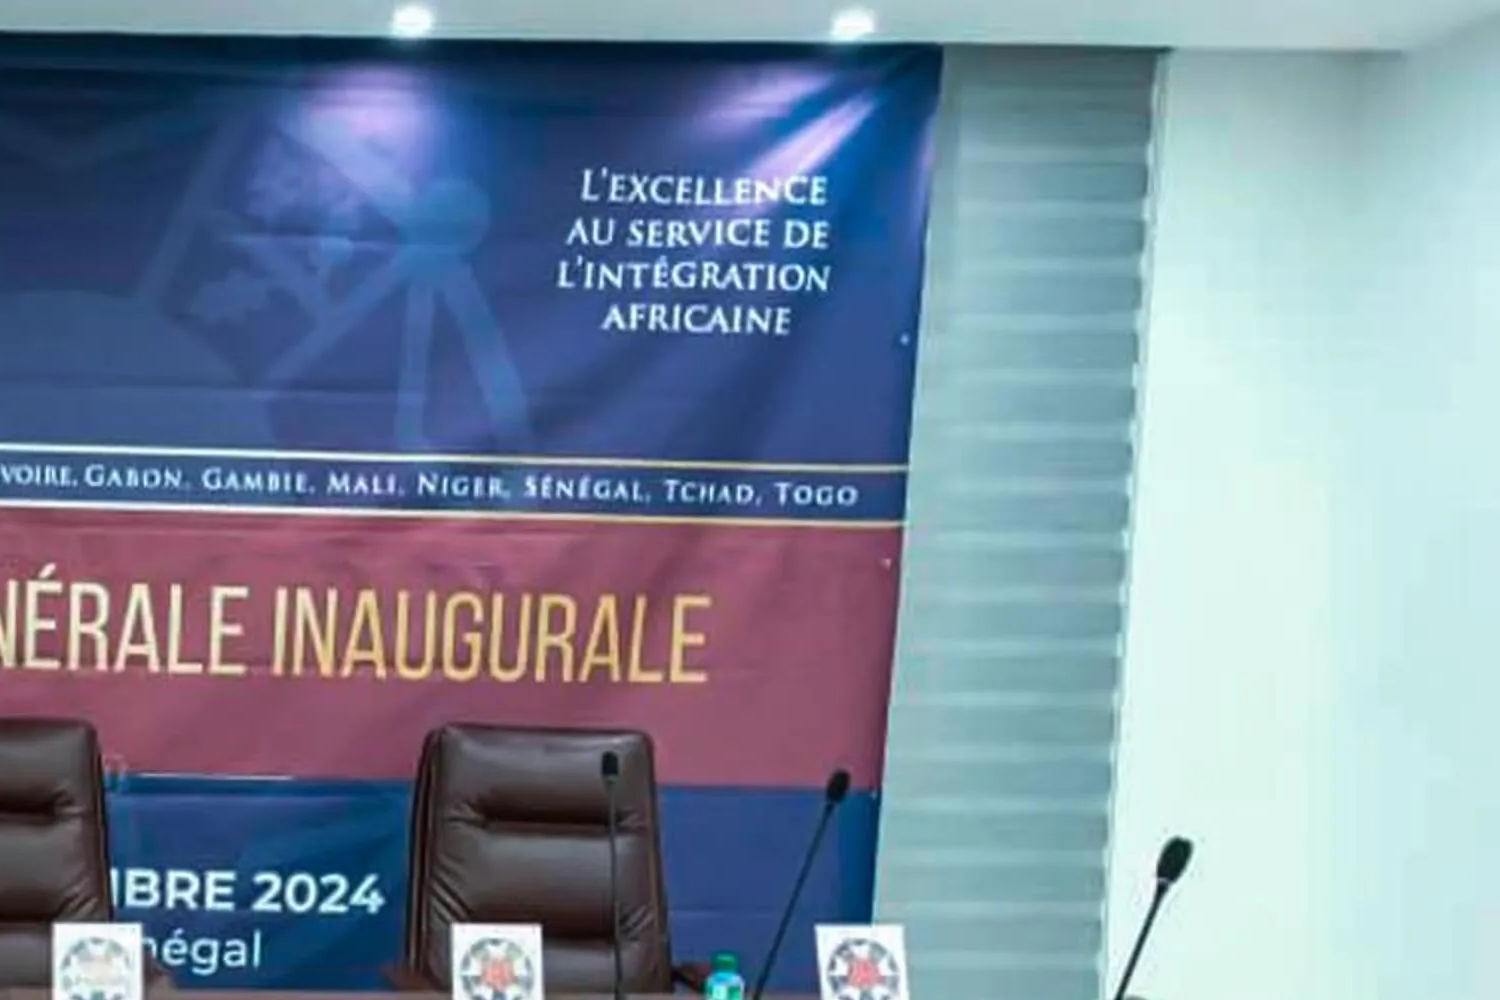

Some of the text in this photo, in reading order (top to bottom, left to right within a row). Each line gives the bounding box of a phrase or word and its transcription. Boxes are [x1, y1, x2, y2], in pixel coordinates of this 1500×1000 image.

[581, 168, 828, 207] L'EXCELLENCE
[565, 217, 829, 250] AU SERVICE DE
[556, 255, 832, 293] L'INTÉGRATION
[601, 303, 792, 336] AFRICAINE
[774, 482, 859, 507] TOGO
[272, 587, 712, 684] INAUGURALE
[252, 871, 385, 914] 2024
